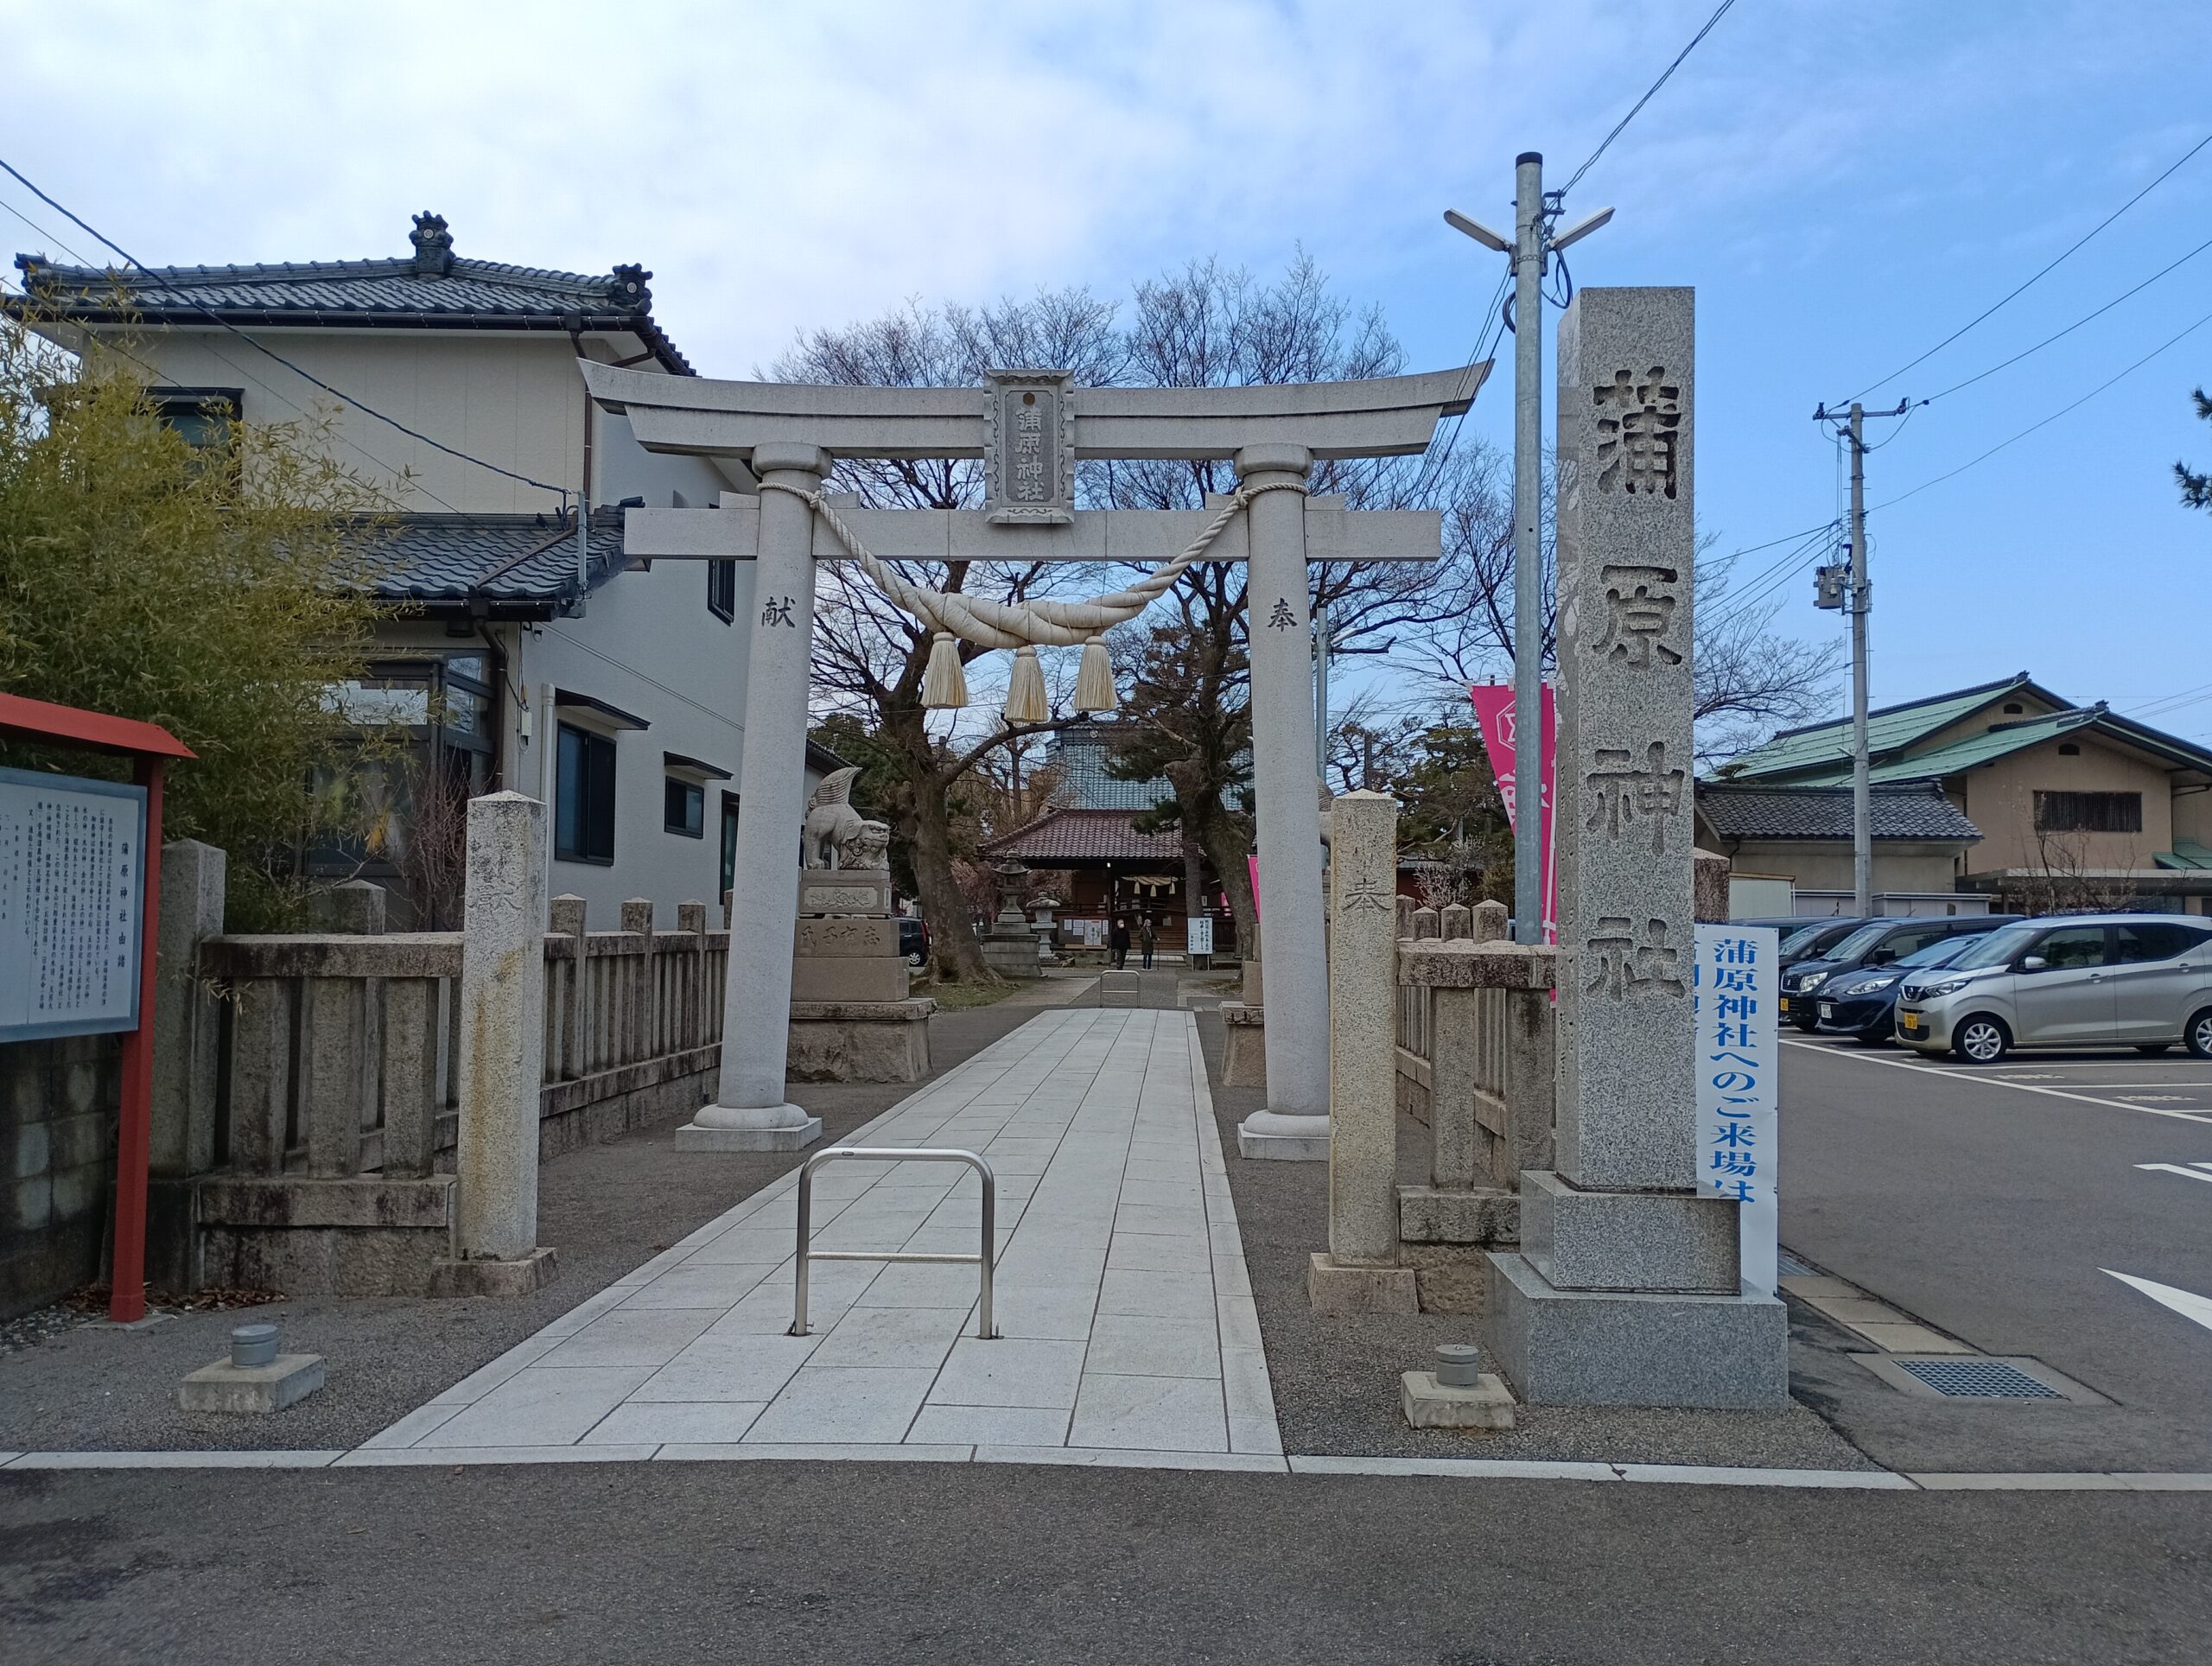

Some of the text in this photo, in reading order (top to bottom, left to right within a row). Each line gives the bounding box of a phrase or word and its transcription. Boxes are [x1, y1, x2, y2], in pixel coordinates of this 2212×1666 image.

[1014, 407, 1045, 501] 蒲原神社
[761, 595, 796, 629] 献
[1267, 597, 1298, 633] 奉
[1586, 365, 1686, 1002] 蒲原神社
[117, 841, 130, 969] 蒲原神社由緒
